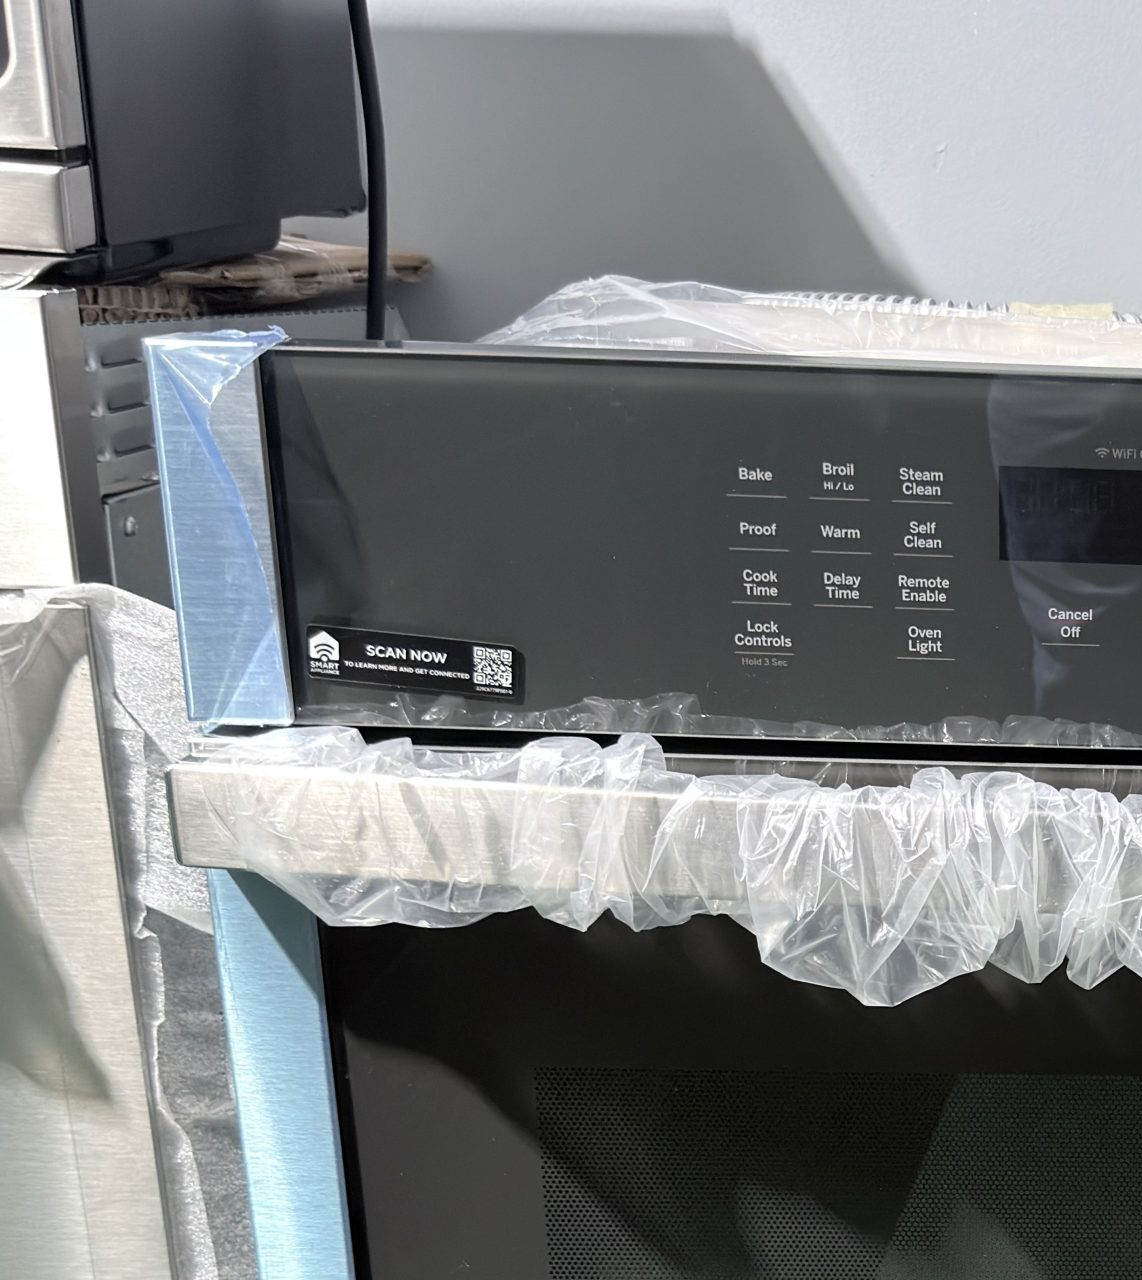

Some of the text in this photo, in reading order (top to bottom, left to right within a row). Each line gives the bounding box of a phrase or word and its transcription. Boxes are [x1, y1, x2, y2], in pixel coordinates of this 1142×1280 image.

[1111, 447, 1137, 460] WiFi
[738, 467, 773, 482] Bake
[822, 462, 855, 476] Broil
[899, 467, 944, 482] Steam
[823, 480, 834, 491] Hi
[842, 481, 855, 491] Lo
[902, 481, 941, 496] Clean
[739, 521, 777, 536] Proof
[820, 524, 861, 539] Warm
[909, 520, 937, 535] Self
[903, 535, 942, 549] Clean
[742, 568, 778, 583] Cook
[823, 571, 862, 590] Delay
[898, 574, 950, 589] Remote
[743, 582, 779, 597] Time
[825, 585, 860, 600] Time
[901, 588, 947, 603] Enable
[1047, 607, 1093, 621] Cancel
[746, 619, 779, 633] Lock
[907, 625, 942, 639] Oven
[1060, 625, 1081, 638] Off
[734, 633, 793, 648] Controls
[908, 639, 943, 655] Light
[366, 643, 448, 664] SCAN NOW
[310, 660, 340, 670] SMART
[741, 656, 789, 667] Hold 3 Sec
[310, 667, 340, 676] APPLIANCE
[344, 660, 354, 668] TO
[355, 661, 378, 670] LEARN
[379, 664, 398, 672] MORE
[399, 666, 414, 674] AND
[429, 670, 471, 680] CONNECTED
